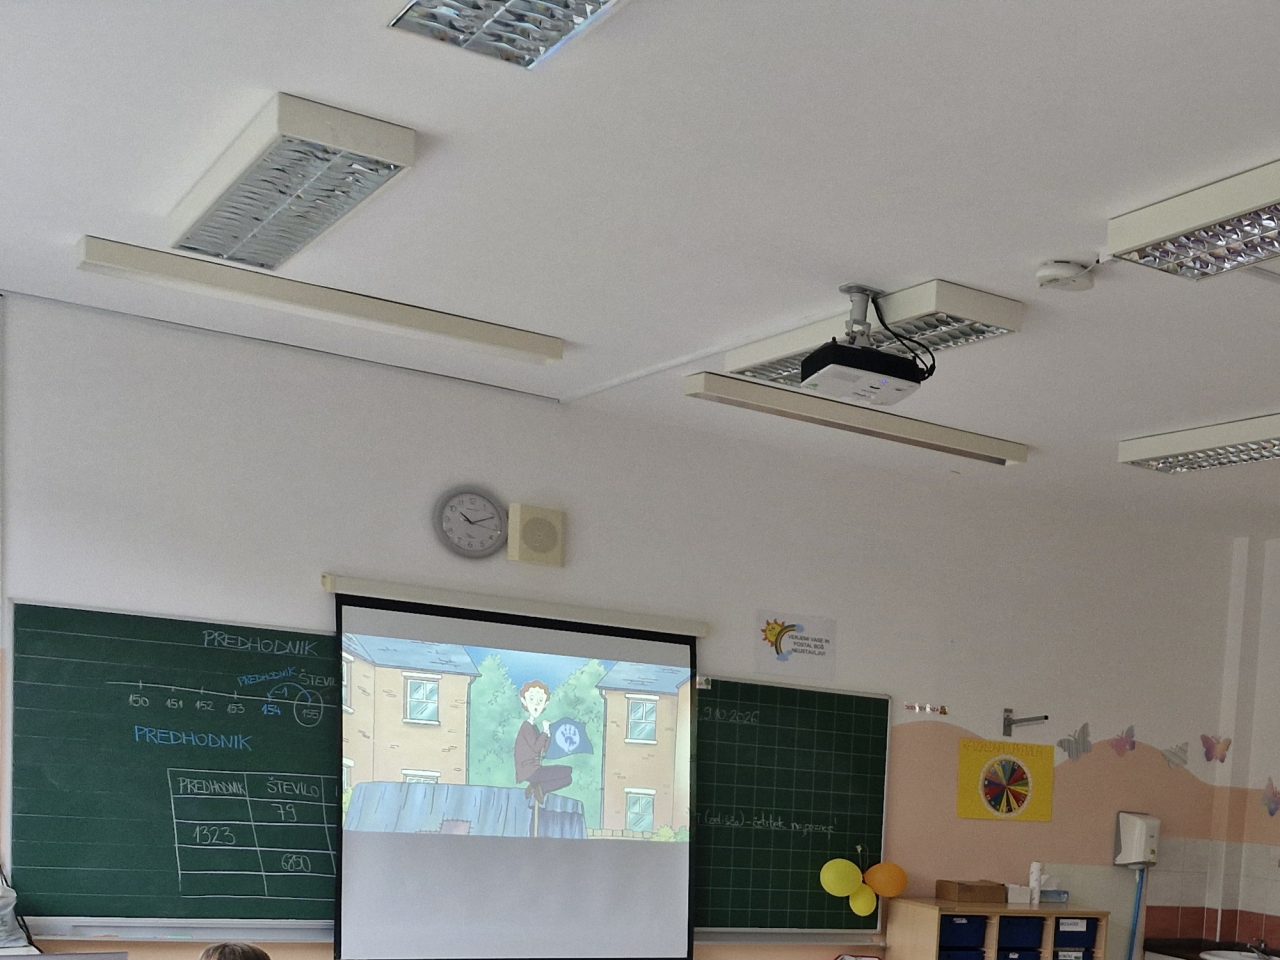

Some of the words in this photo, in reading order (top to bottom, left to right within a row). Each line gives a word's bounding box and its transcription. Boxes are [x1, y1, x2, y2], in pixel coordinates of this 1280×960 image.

[203, 629, 319, 656] PREDHODNIK
[299, 668, 337, 687] ŠTEVIL
[128, 693, 149, 708] 150
[166, 697, 184, 710] 151
[195, 698, 215, 712] 152
[226, 701, 246, 714] 153
[261, 703, 281, 716] 154
[302, 708, 320, 719] 155
[135, 724, 253, 751] PREDHODNIK
[180, 777, 248, 795] PREDHODNIK
[267, 775, 320, 797] ŠTEVILO
[271, 803, 298, 822] 79
[193, 825, 237, 846] 1323
